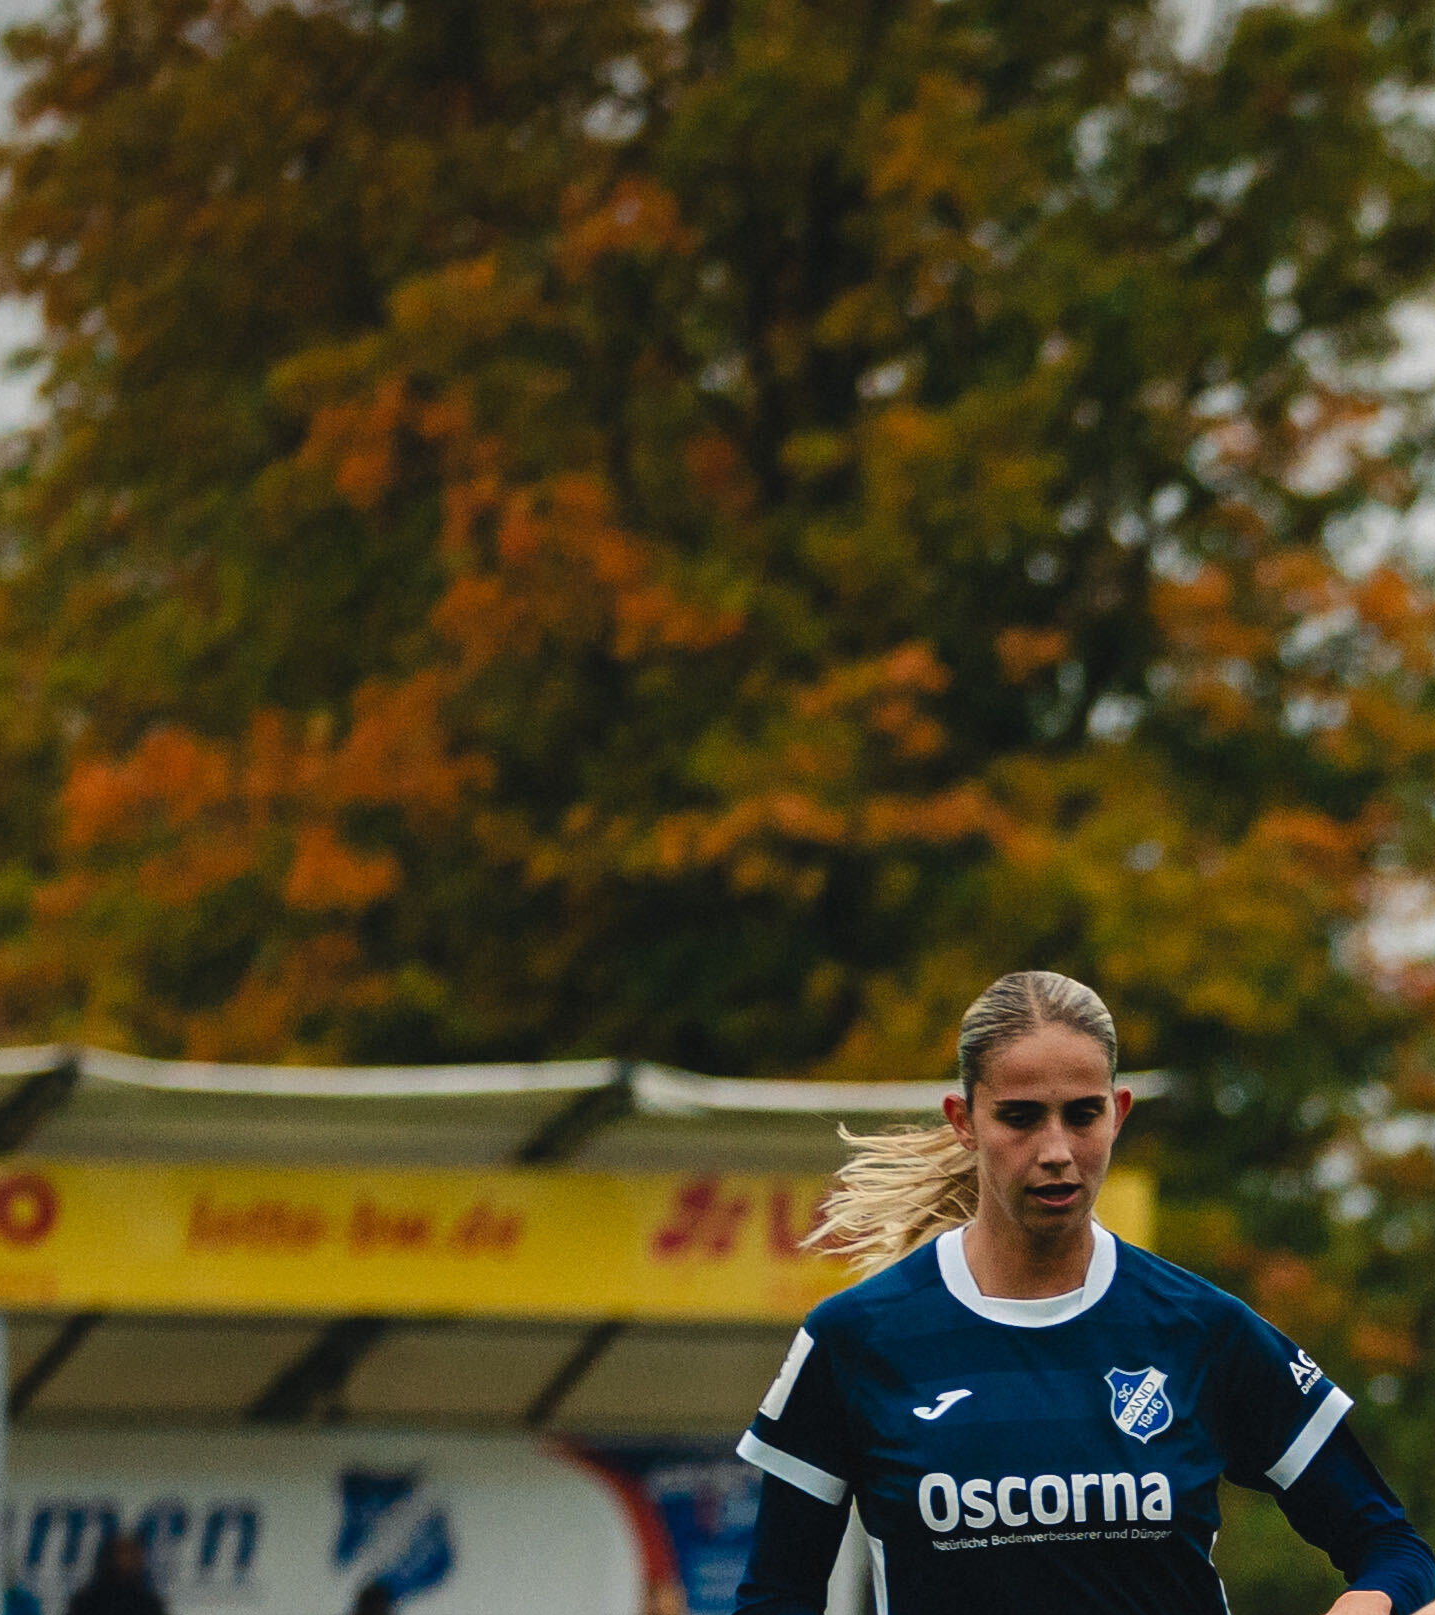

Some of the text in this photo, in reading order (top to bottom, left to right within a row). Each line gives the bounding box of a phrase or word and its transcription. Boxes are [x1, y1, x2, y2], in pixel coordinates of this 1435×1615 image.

[1117, 1382, 1134, 1403] SC
[1122, 1381, 1156, 1425] SAND
[1137, 1398, 1164, 1429] 1946
[918, 1472, 1172, 1533] Oscorna
[991, 1529, 1102, 1545] Bodenverbesserer
[1104, 1528, 1128, 1540] und
[1131, 1528, 1172, 1541] Dünger
